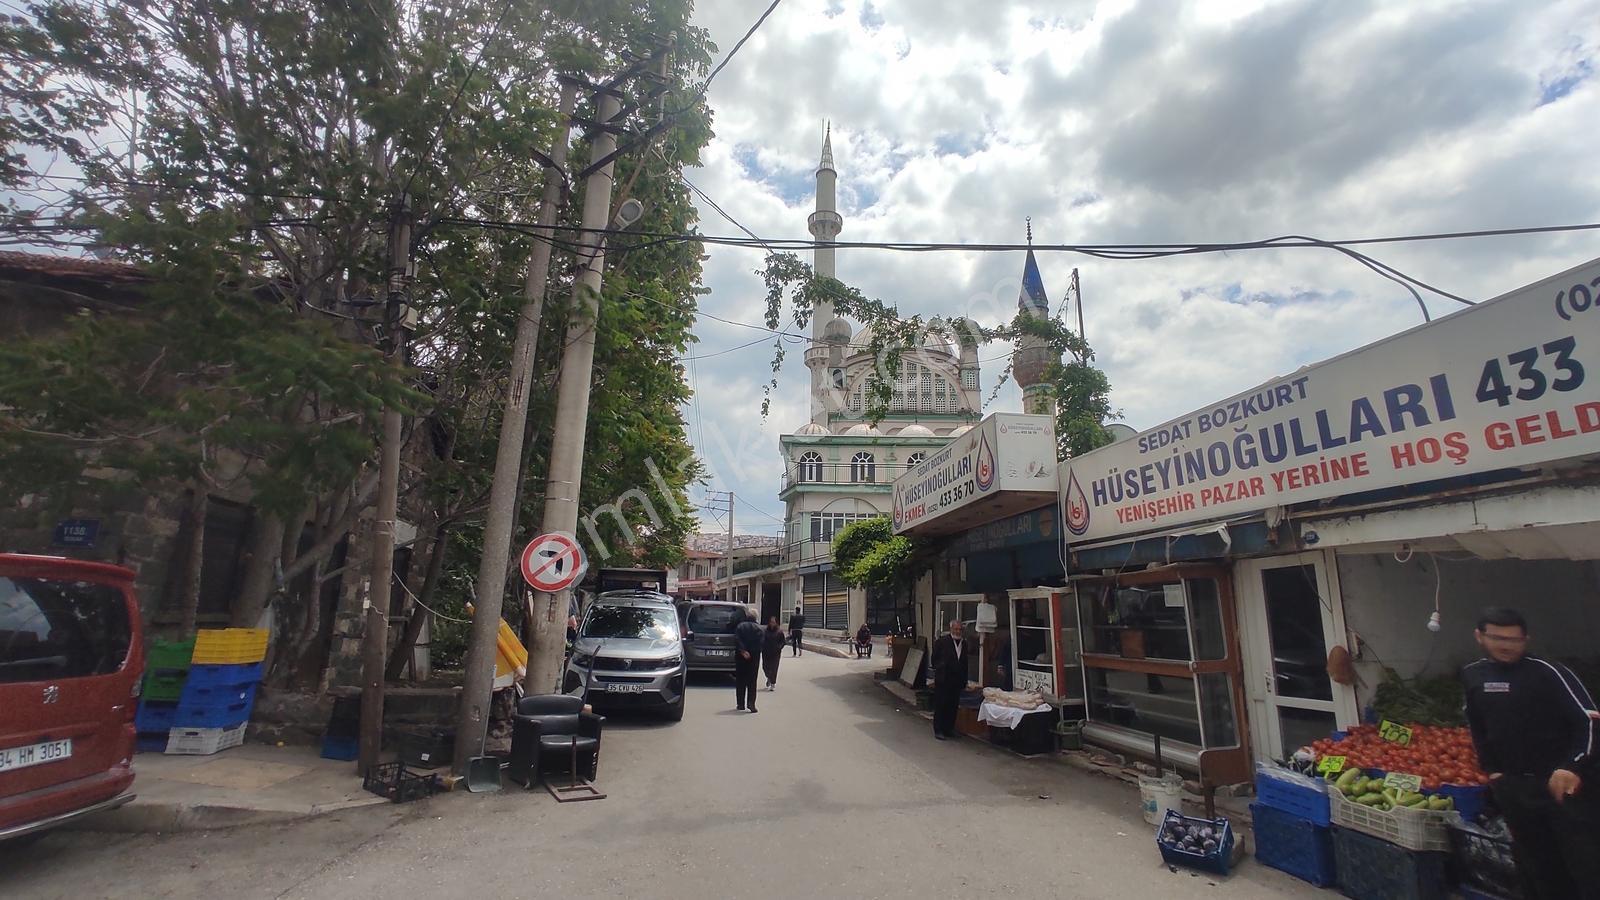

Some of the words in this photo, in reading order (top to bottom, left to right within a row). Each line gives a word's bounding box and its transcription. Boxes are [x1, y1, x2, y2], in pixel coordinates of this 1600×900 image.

[1092, 373, 1457, 507] HÜSEYİNOĞULLARI
[1475, 335, 1586, 408] 433
[1138, 420, 1192, 453] SEDAT
[1198, 376, 1309, 433] BOZKURT
[904, 454, 972, 506] HÜSEYİNOĞULLARI
[917, 461, 931, 478] SEDAT
[931, 448, 953, 470] BOZKURT
[1116, 491, 1196, 524] YENİŞEHİR
[1200, 476, 1265, 507] PAZAR
[1270, 453, 1370, 493] YERİNE
[1390, 431, 1470, 470] HOŞ
[904, 502, 927, 524] EKMEK
[939, 490, 952, 508] 433
[953, 485, 963, 502] 36
[964, 479, 975, 498] 70
[19, 747, 34, 764] HM
[40, 741, 68, 760] 3051
